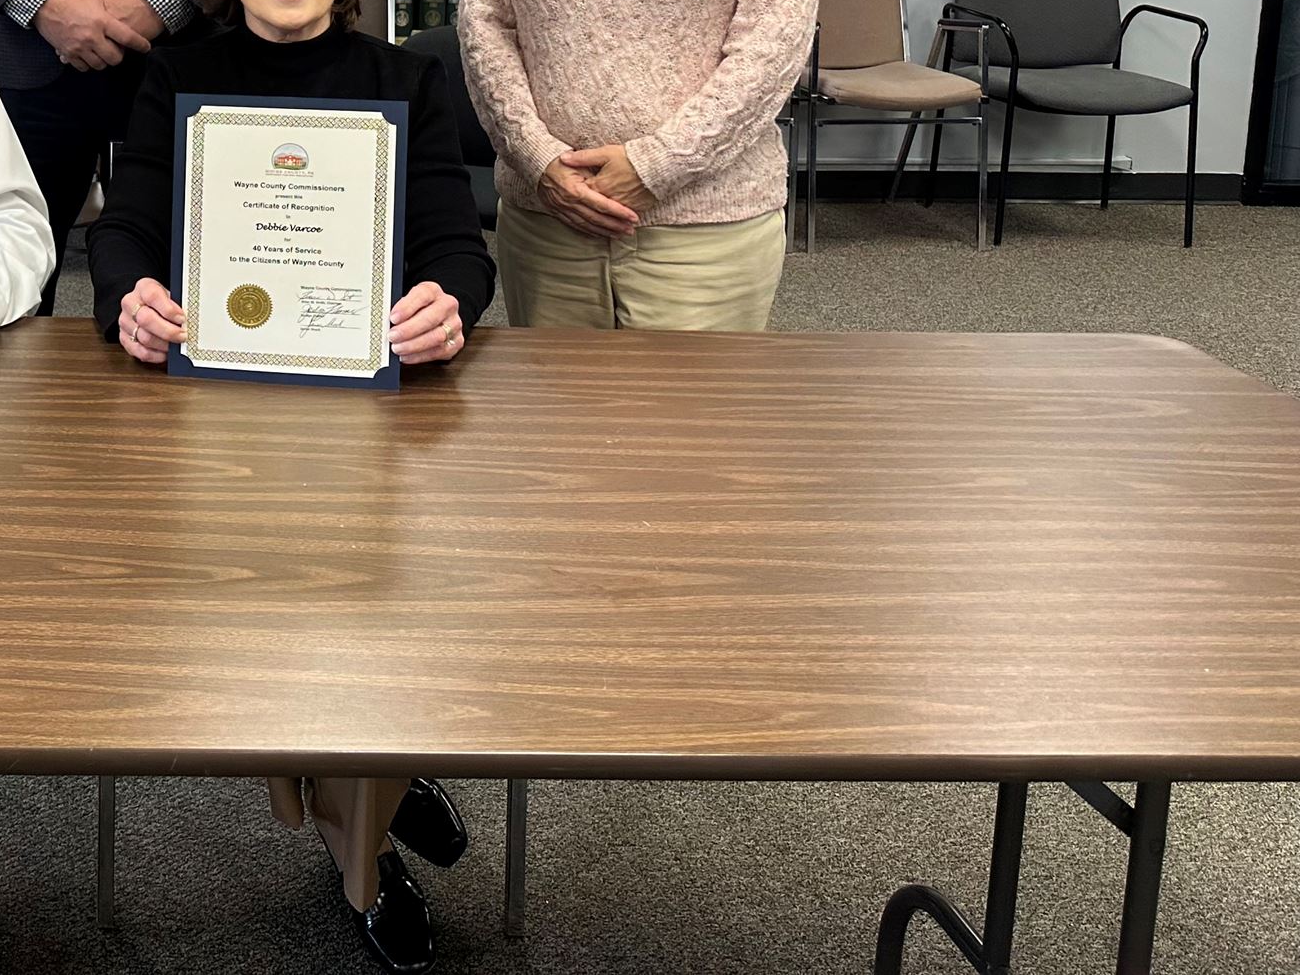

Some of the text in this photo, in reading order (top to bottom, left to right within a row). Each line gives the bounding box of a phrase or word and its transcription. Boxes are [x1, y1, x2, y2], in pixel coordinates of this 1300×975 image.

[234, 181, 344, 192] Wayne County Commissioners
[243, 201, 280, 209] Certificate
[291, 204, 334, 212] Recognition
[256, 222, 323, 233] Debbie Varcoe
[318, 260, 344, 268] County
